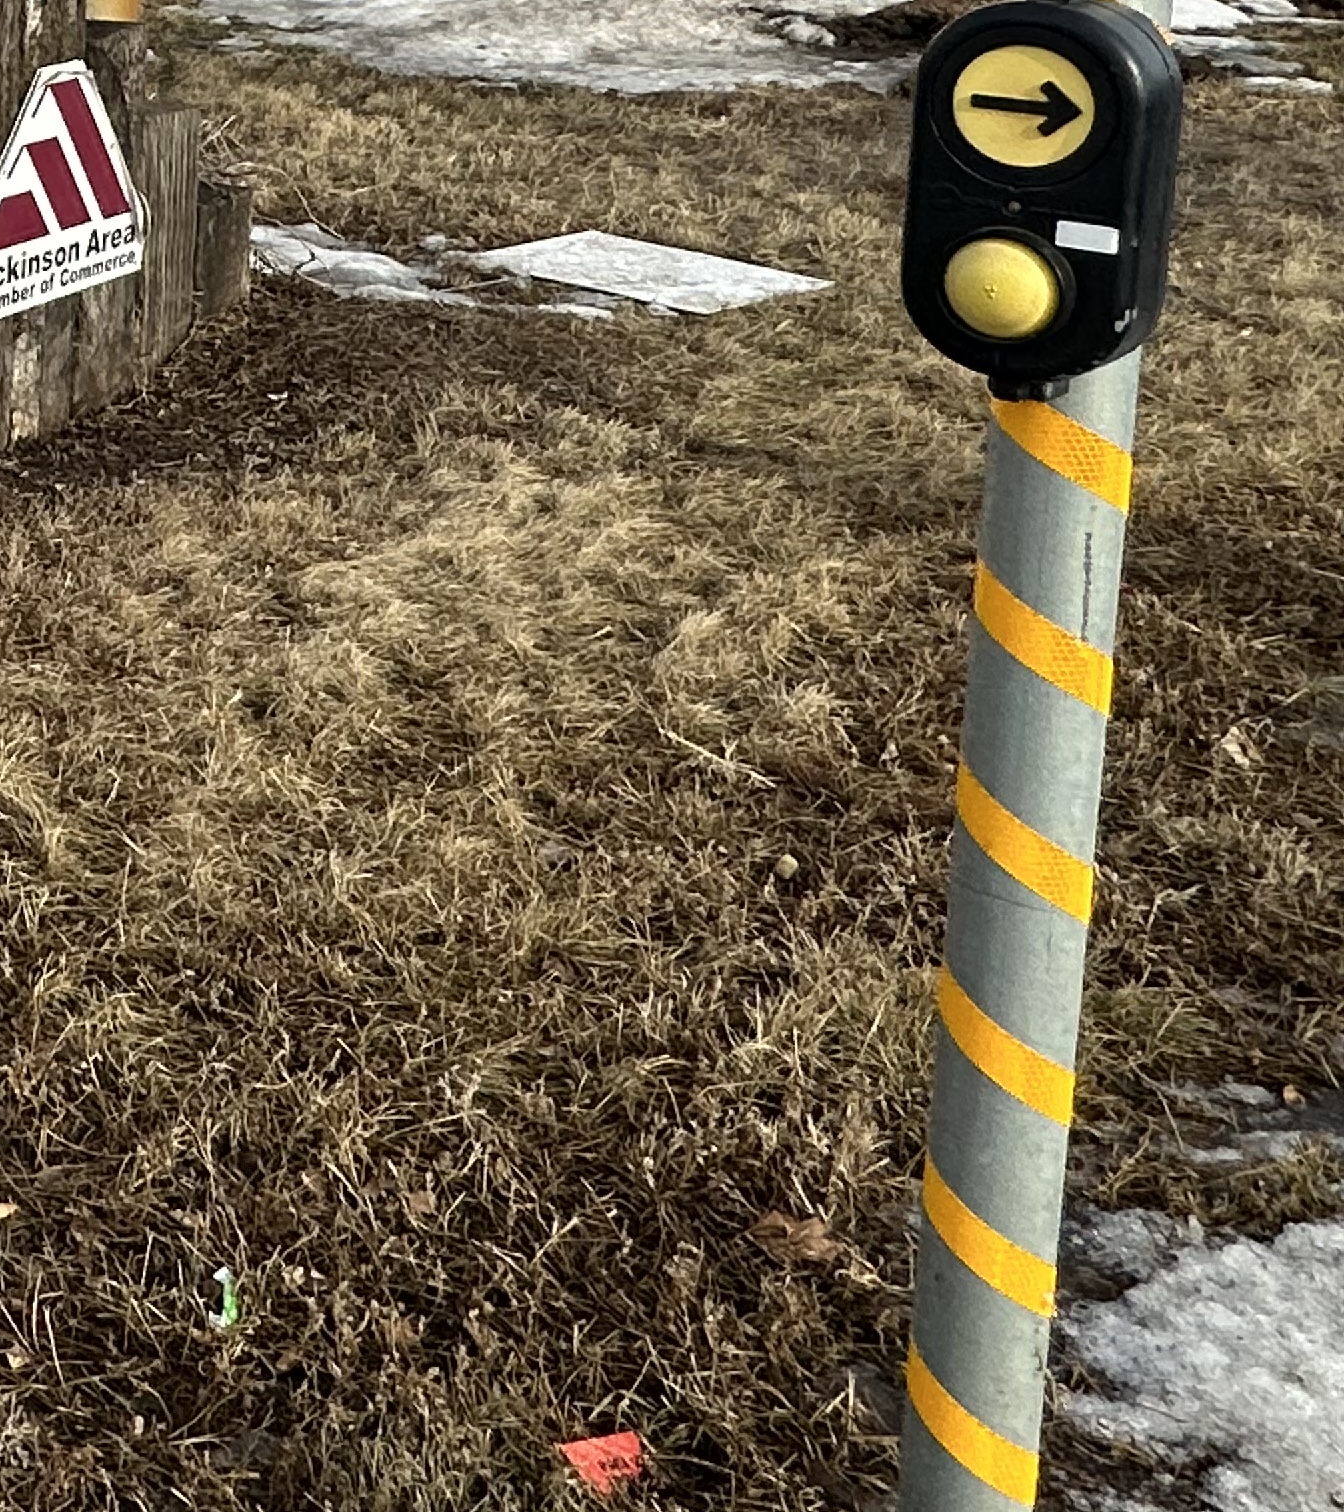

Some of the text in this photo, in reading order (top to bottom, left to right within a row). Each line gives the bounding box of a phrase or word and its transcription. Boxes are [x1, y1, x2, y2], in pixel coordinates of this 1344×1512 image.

[85, 223, 135, 258] Area
[40, 275, 55, 296] of
[60, 250, 137, 287] Commerce
